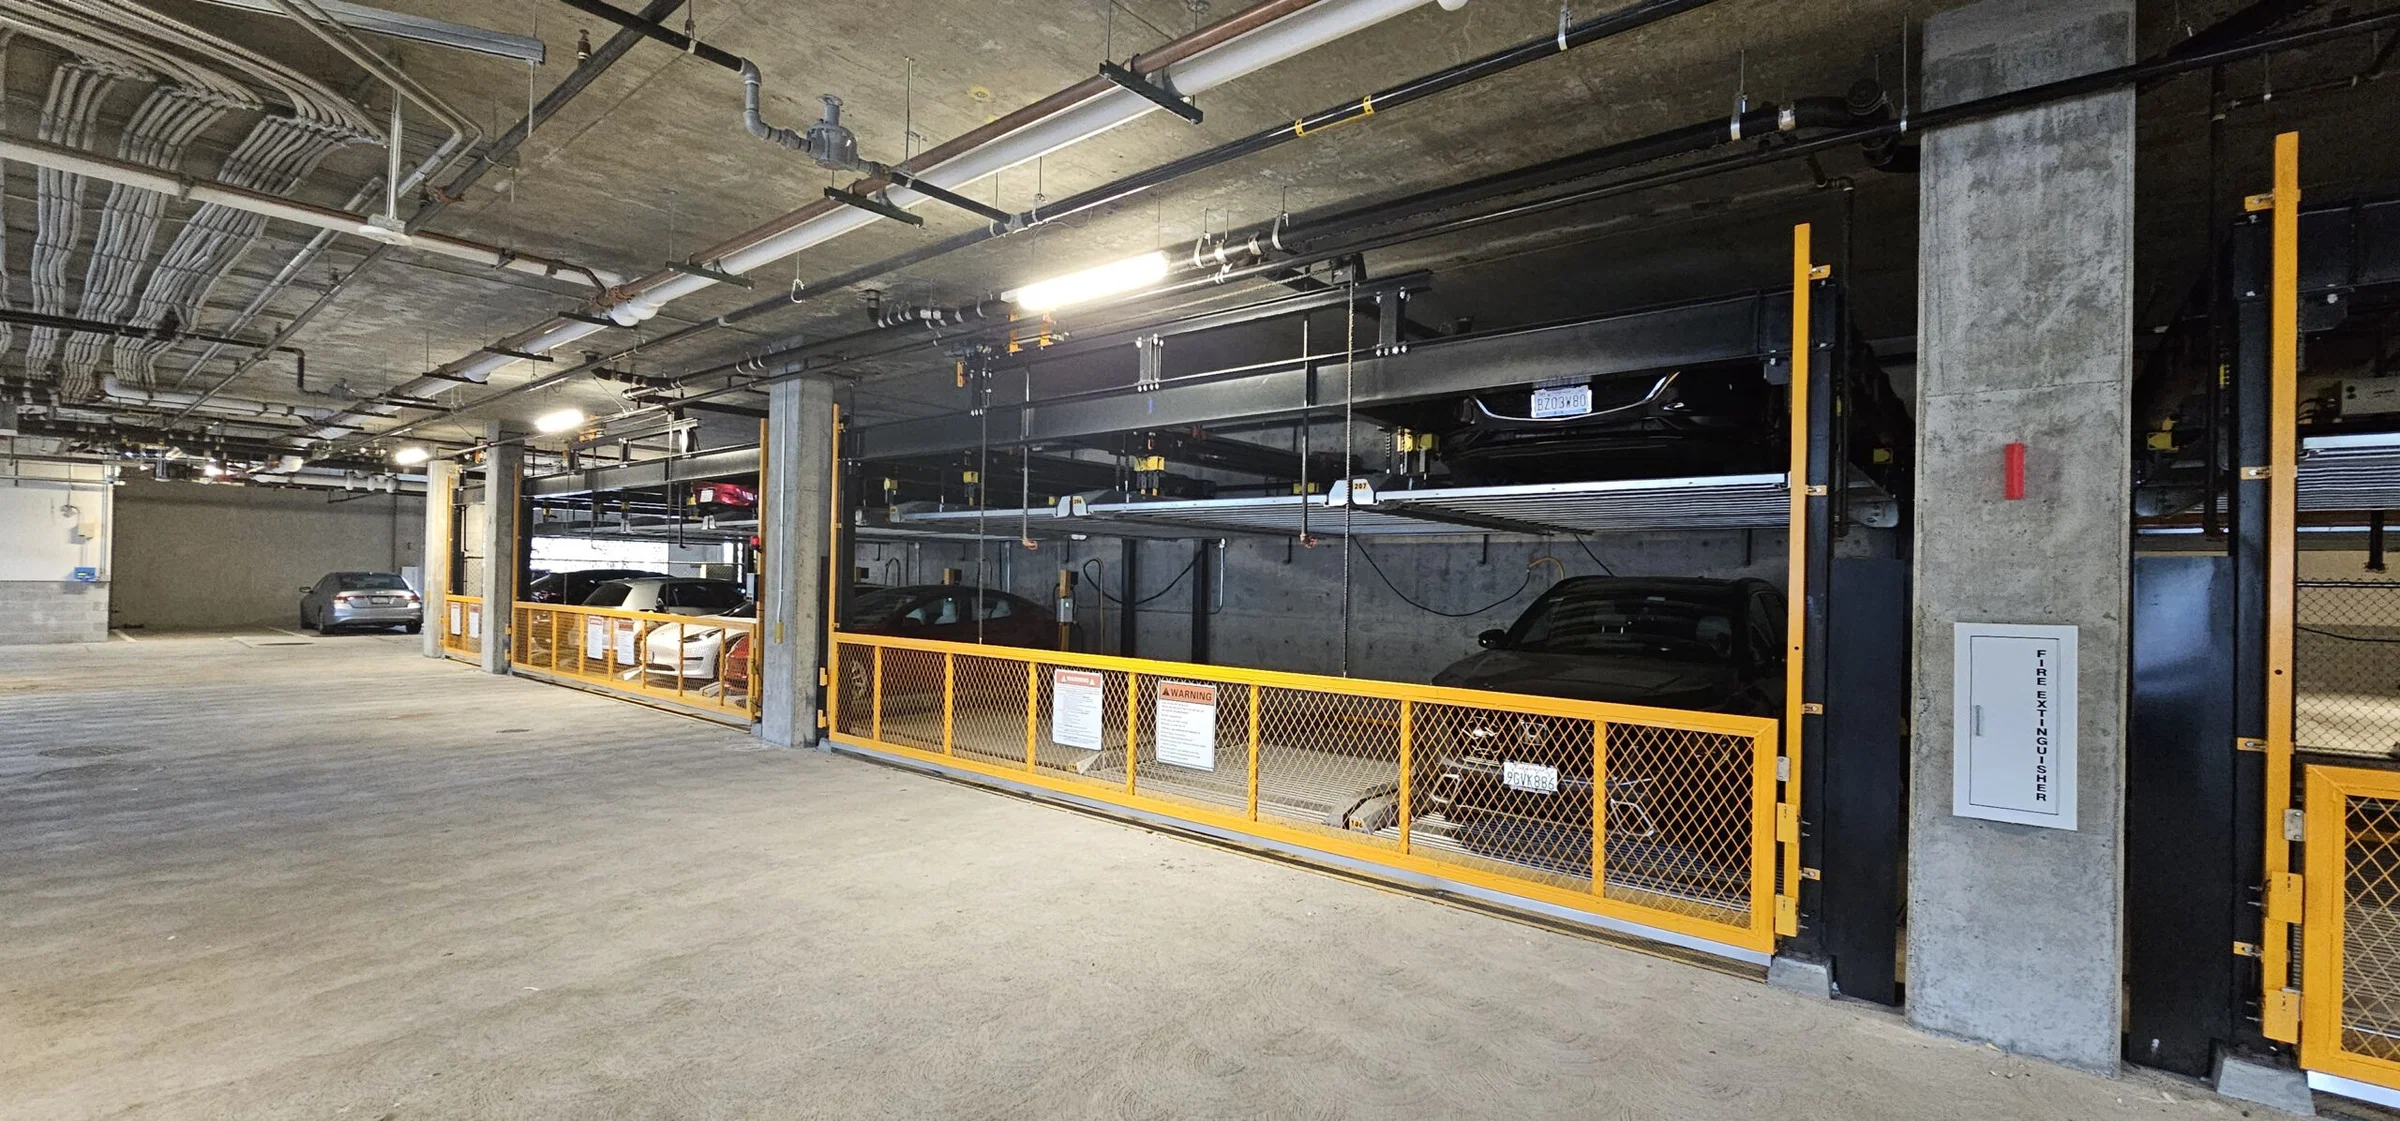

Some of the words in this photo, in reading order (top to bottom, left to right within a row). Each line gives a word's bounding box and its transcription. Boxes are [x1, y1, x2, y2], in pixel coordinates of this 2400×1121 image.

[2036, 650, 2047, 685] FIRE
[1170, 688, 1212, 701] WARNING
[2036, 690, 2047, 801] EXTINGUISHER
[1507, 771, 1555, 790] 9GVK886
